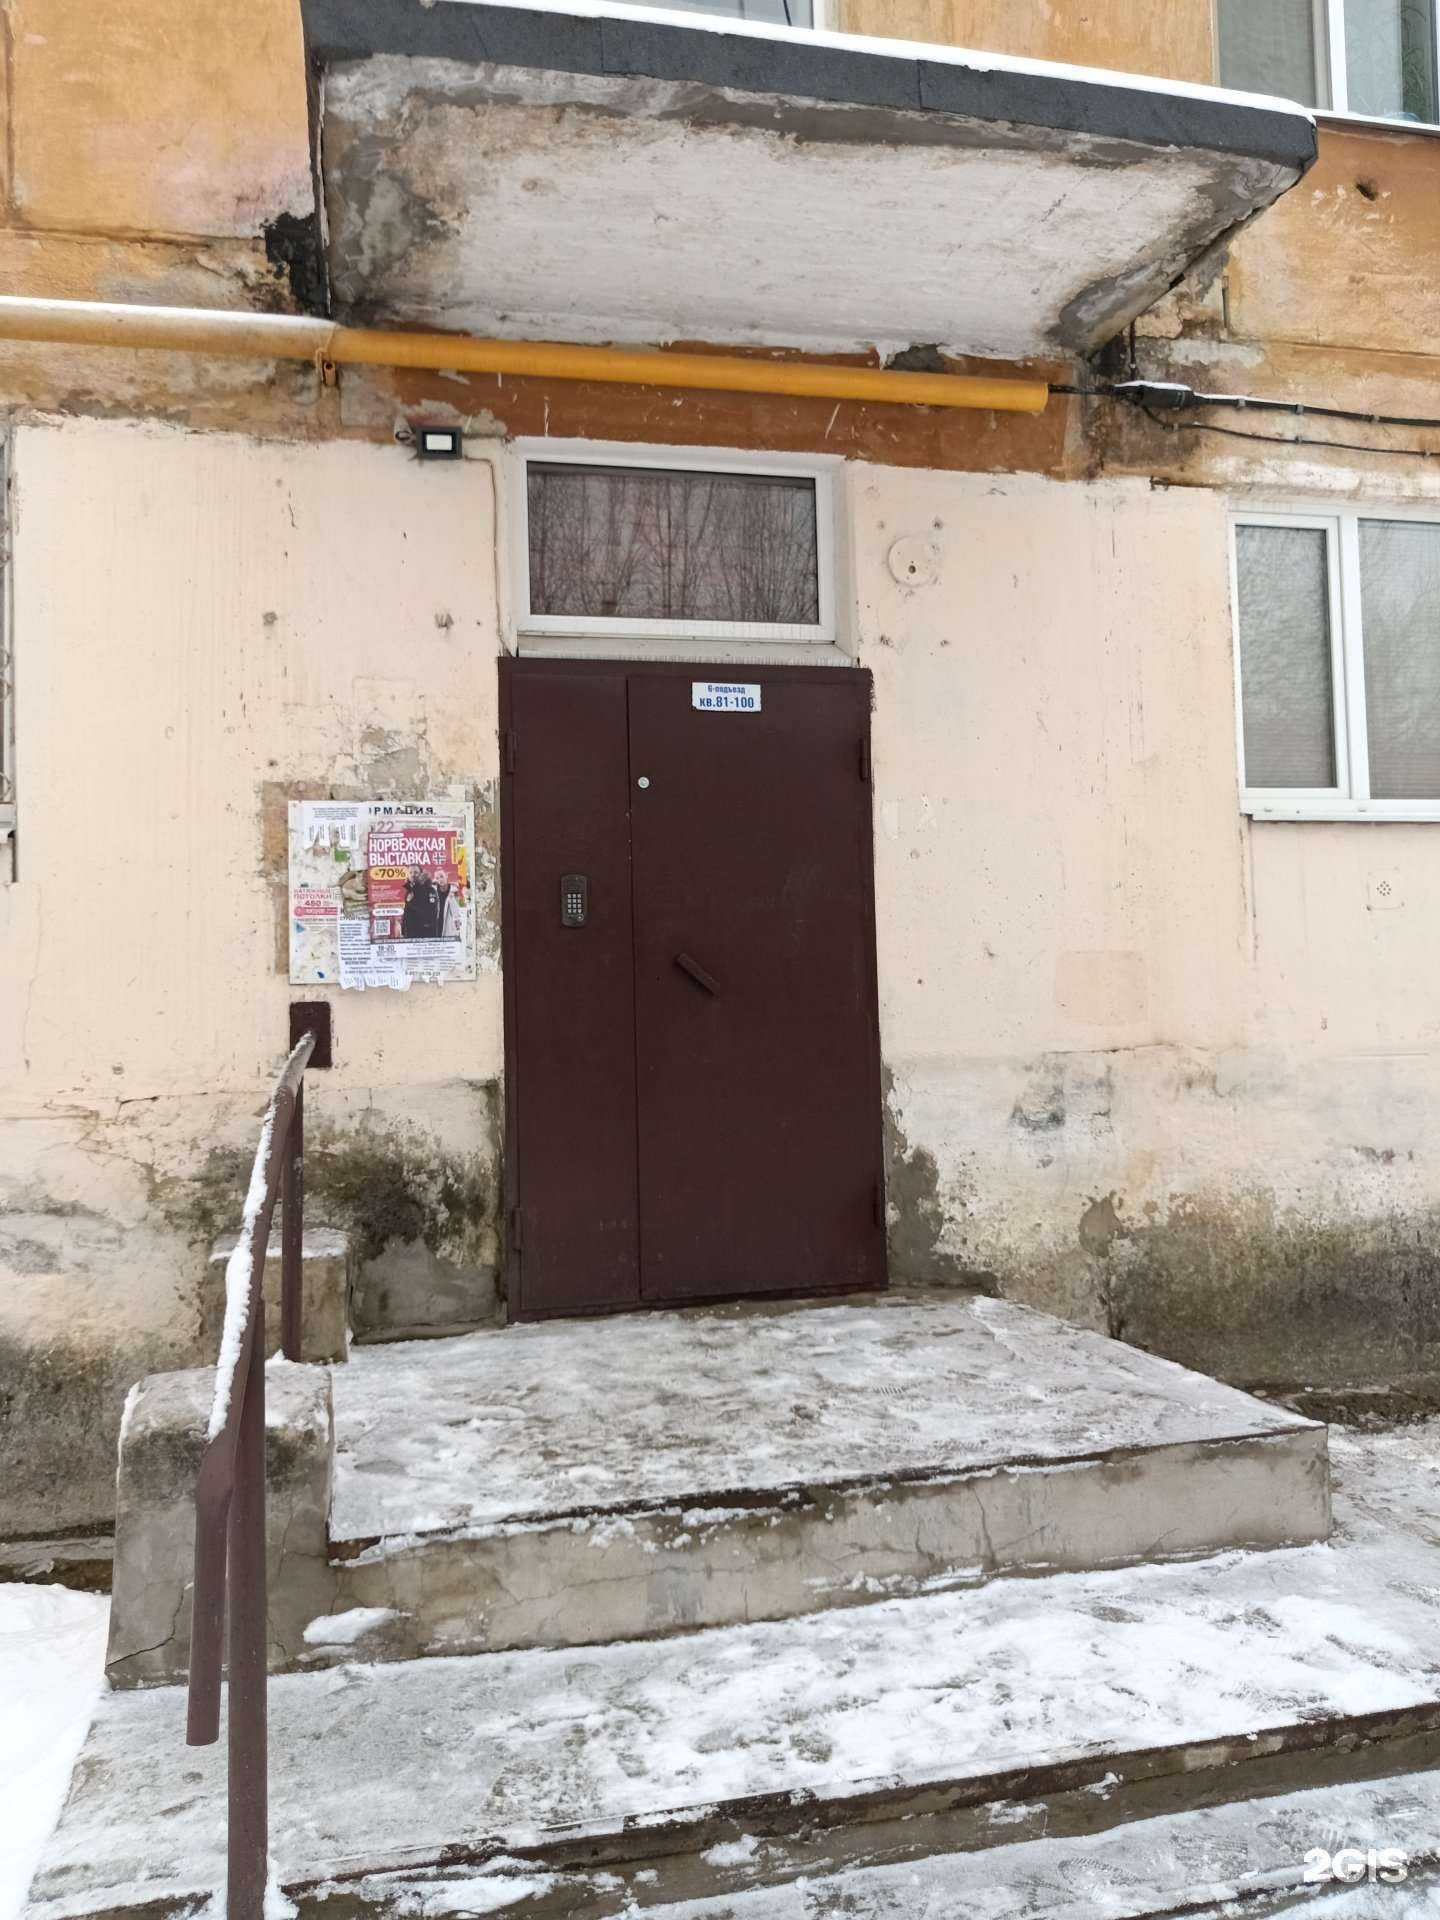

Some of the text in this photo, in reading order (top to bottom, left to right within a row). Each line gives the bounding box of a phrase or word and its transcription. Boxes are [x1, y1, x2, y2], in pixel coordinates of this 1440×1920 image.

[699, 696, 754, 708] кв.81-100
[368, 805, 437, 816] РМАЦИЯ.
[369, 838, 446, 852] НОРВЕЖСКАЯ
[369, 851, 431, 866] ВЫСТАВКА
[375, 868, 406, 878] -70%
